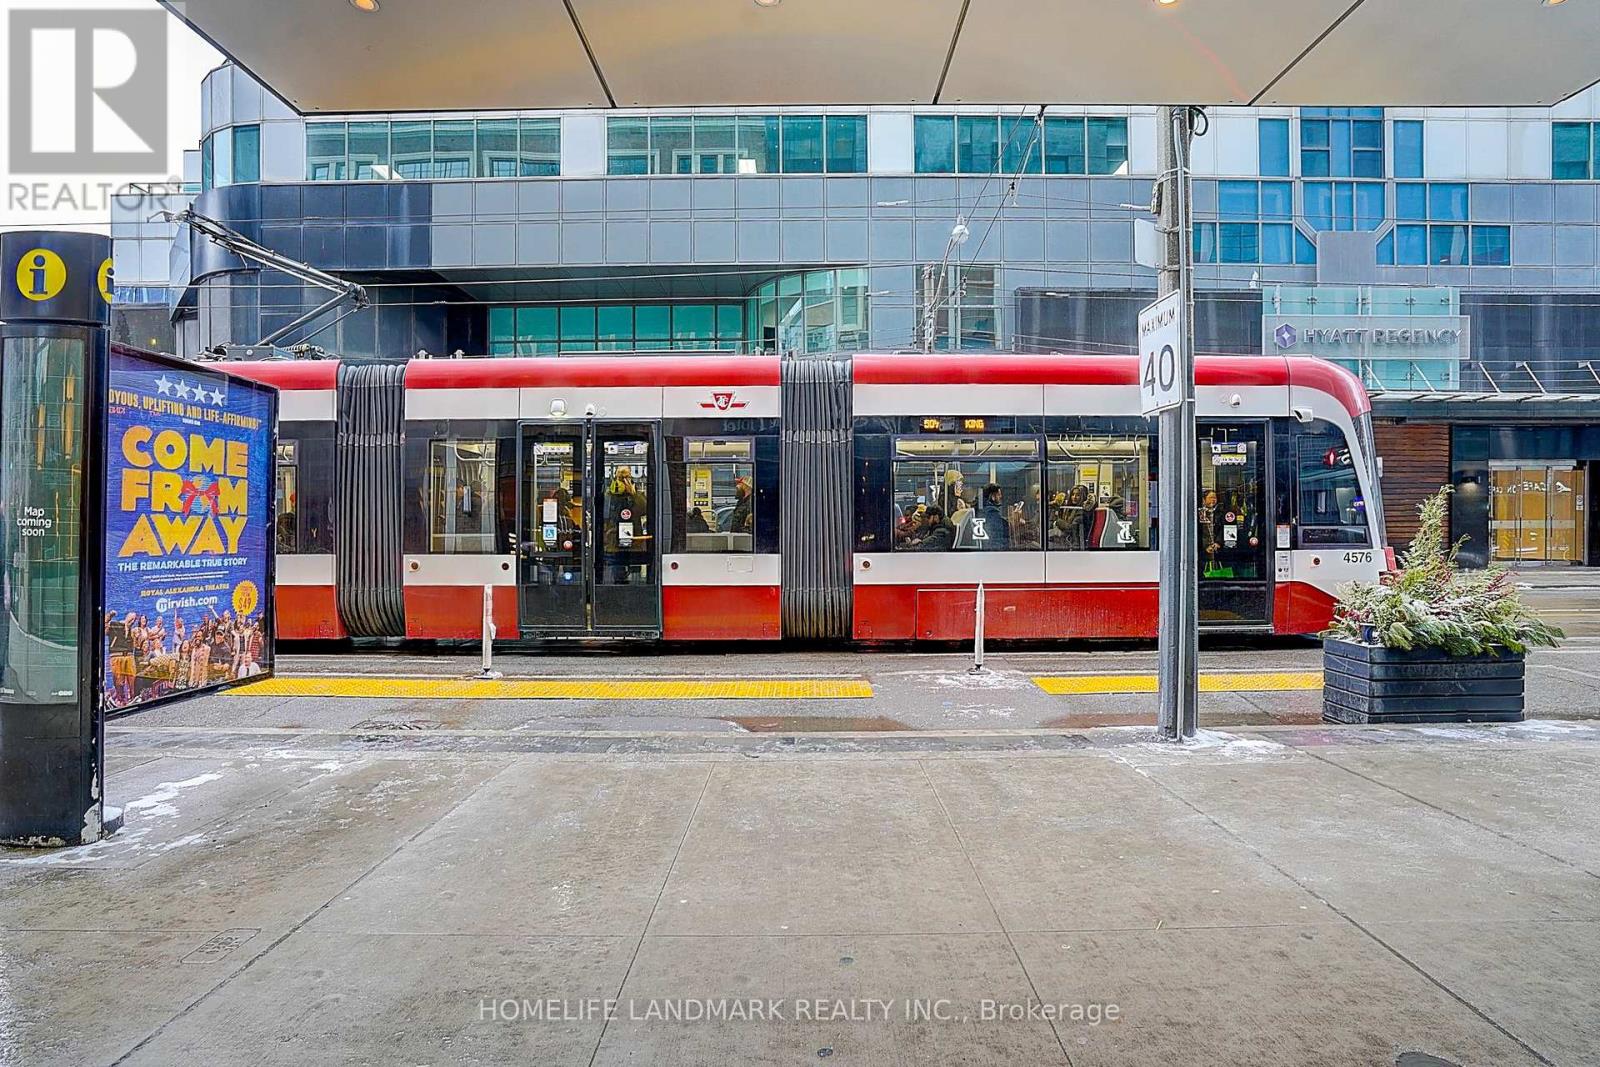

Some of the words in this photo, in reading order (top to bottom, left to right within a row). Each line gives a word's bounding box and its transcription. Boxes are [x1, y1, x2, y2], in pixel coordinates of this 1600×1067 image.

[1142, 307, 1176, 335] MAXIMUM
[1303, 328, 1368, 345] HYATT
[1372, 328, 1463, 345] REGENCY
[1143, 344, 1175, 397] 40
[143, 396, 184, 417] UPLIFTING
[187, 405, 202, 419] AND
[965, 419, 985, 430] KING
[122, 426, 248, 477] COME
[24, 506, 45, 517] Map
[16, 517, 52, 528] coming
[21, 528, 45, 537] soon
[118, 513, 248, 557] AWAY
[117, 561, 138, 572] THE
[140, 558, 200, 571] REMARKABLE
[201, 557, 222, 568] TRUE
[223, 556, 248, 567] STORY
[1343, 551, 1372, 563] 4576
[140, 589, 163, 597] ROYAL
[164, 585, 204, 595] ALEXANDRA
